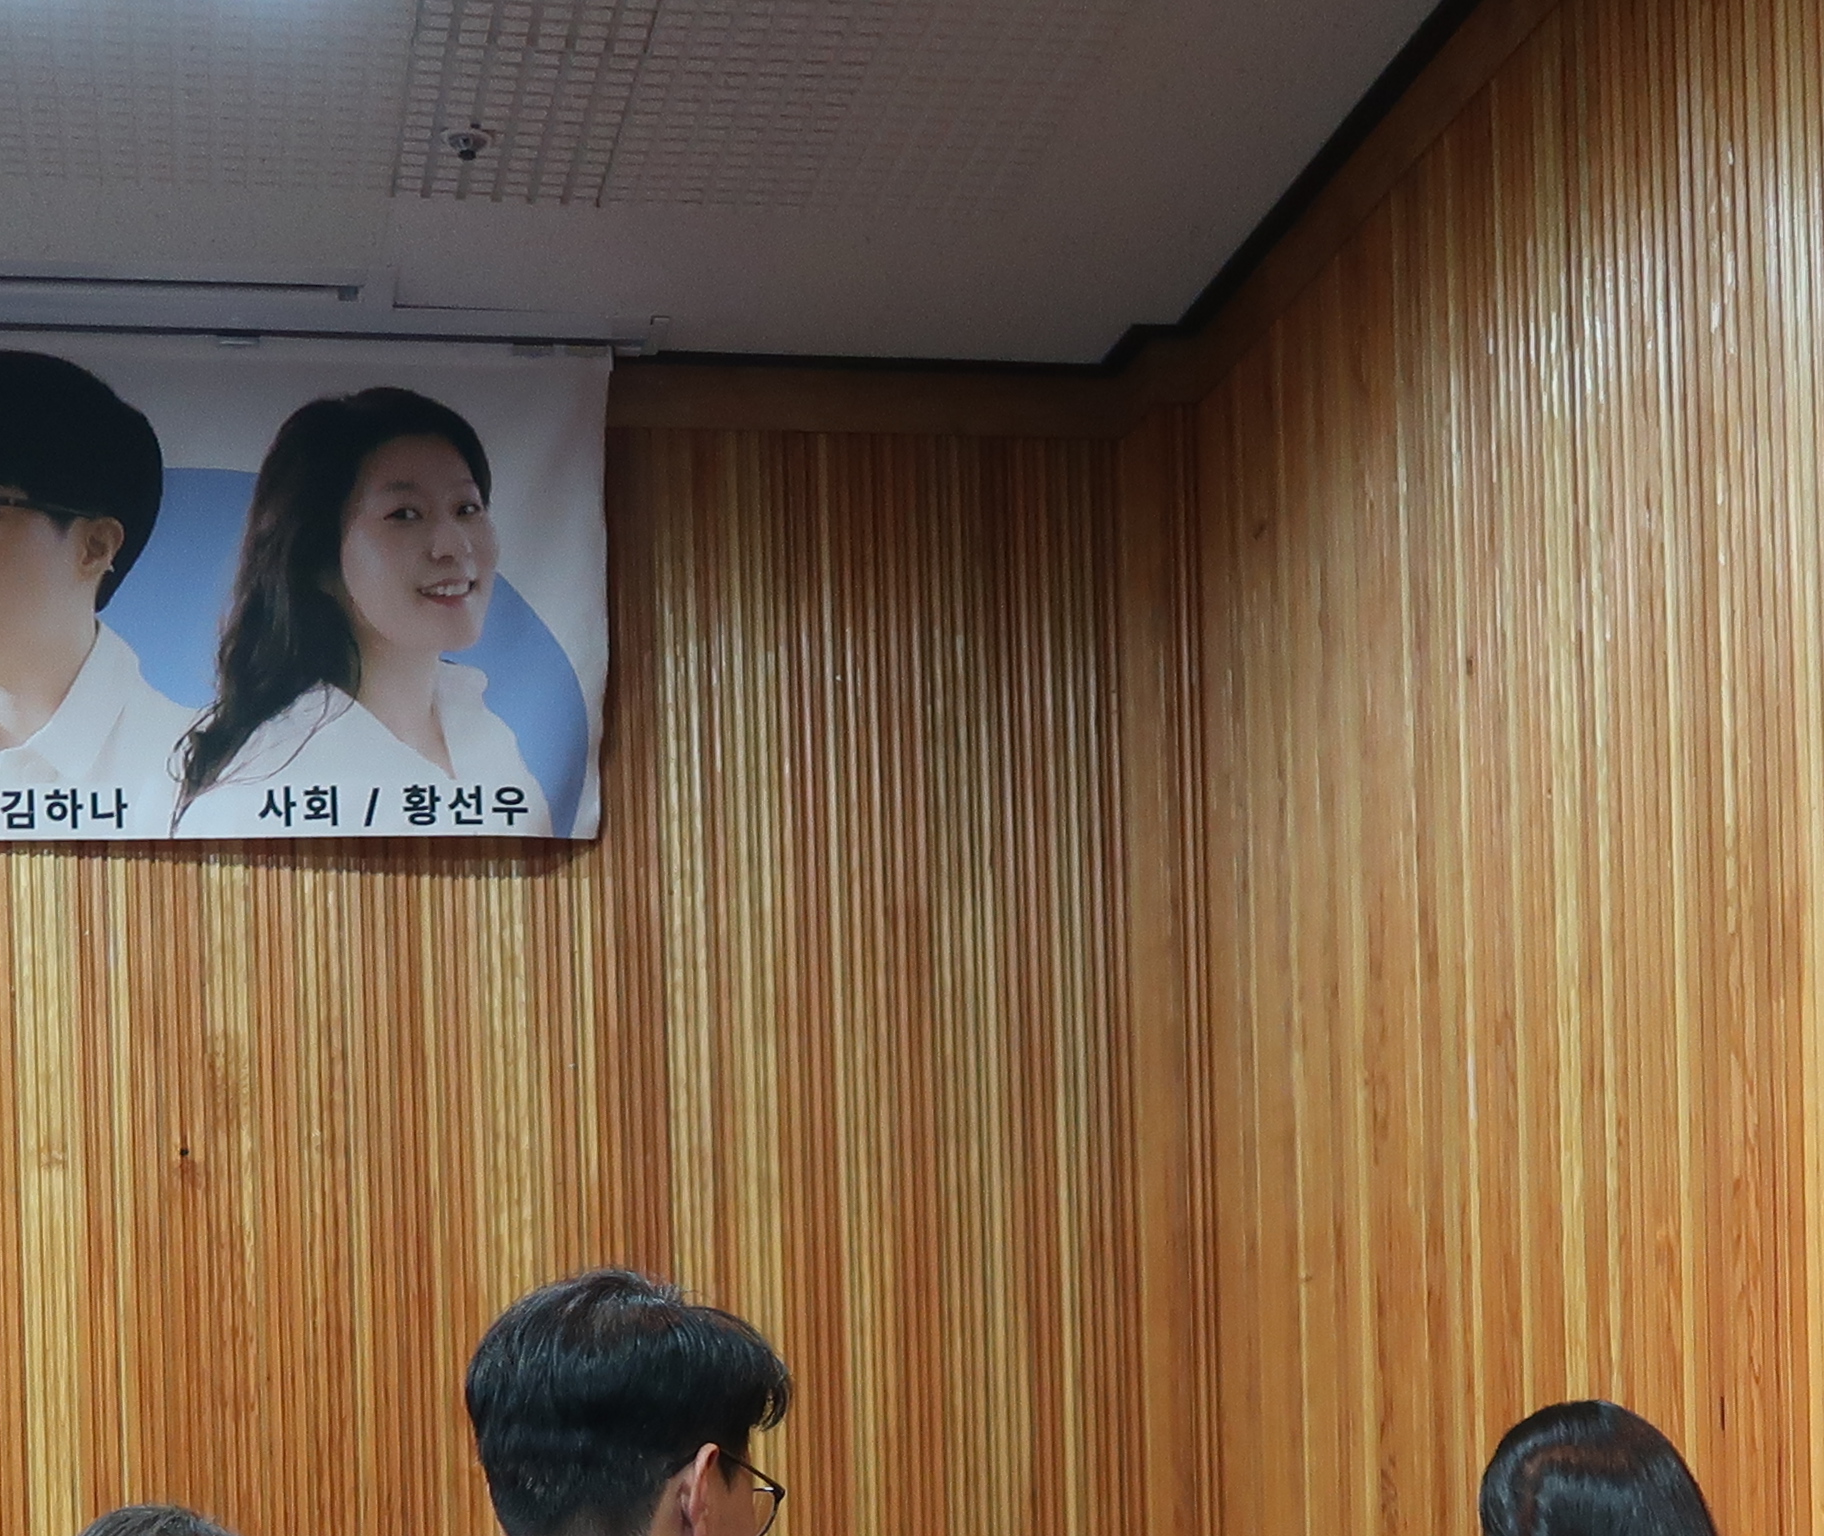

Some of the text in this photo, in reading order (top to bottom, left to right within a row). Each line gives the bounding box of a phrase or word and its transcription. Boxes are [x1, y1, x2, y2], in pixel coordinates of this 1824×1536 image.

[0, 788, 128, 830] 김하나
[258, 785, 340, 827] 사회
[402, 784, 529, 826] 황선우
